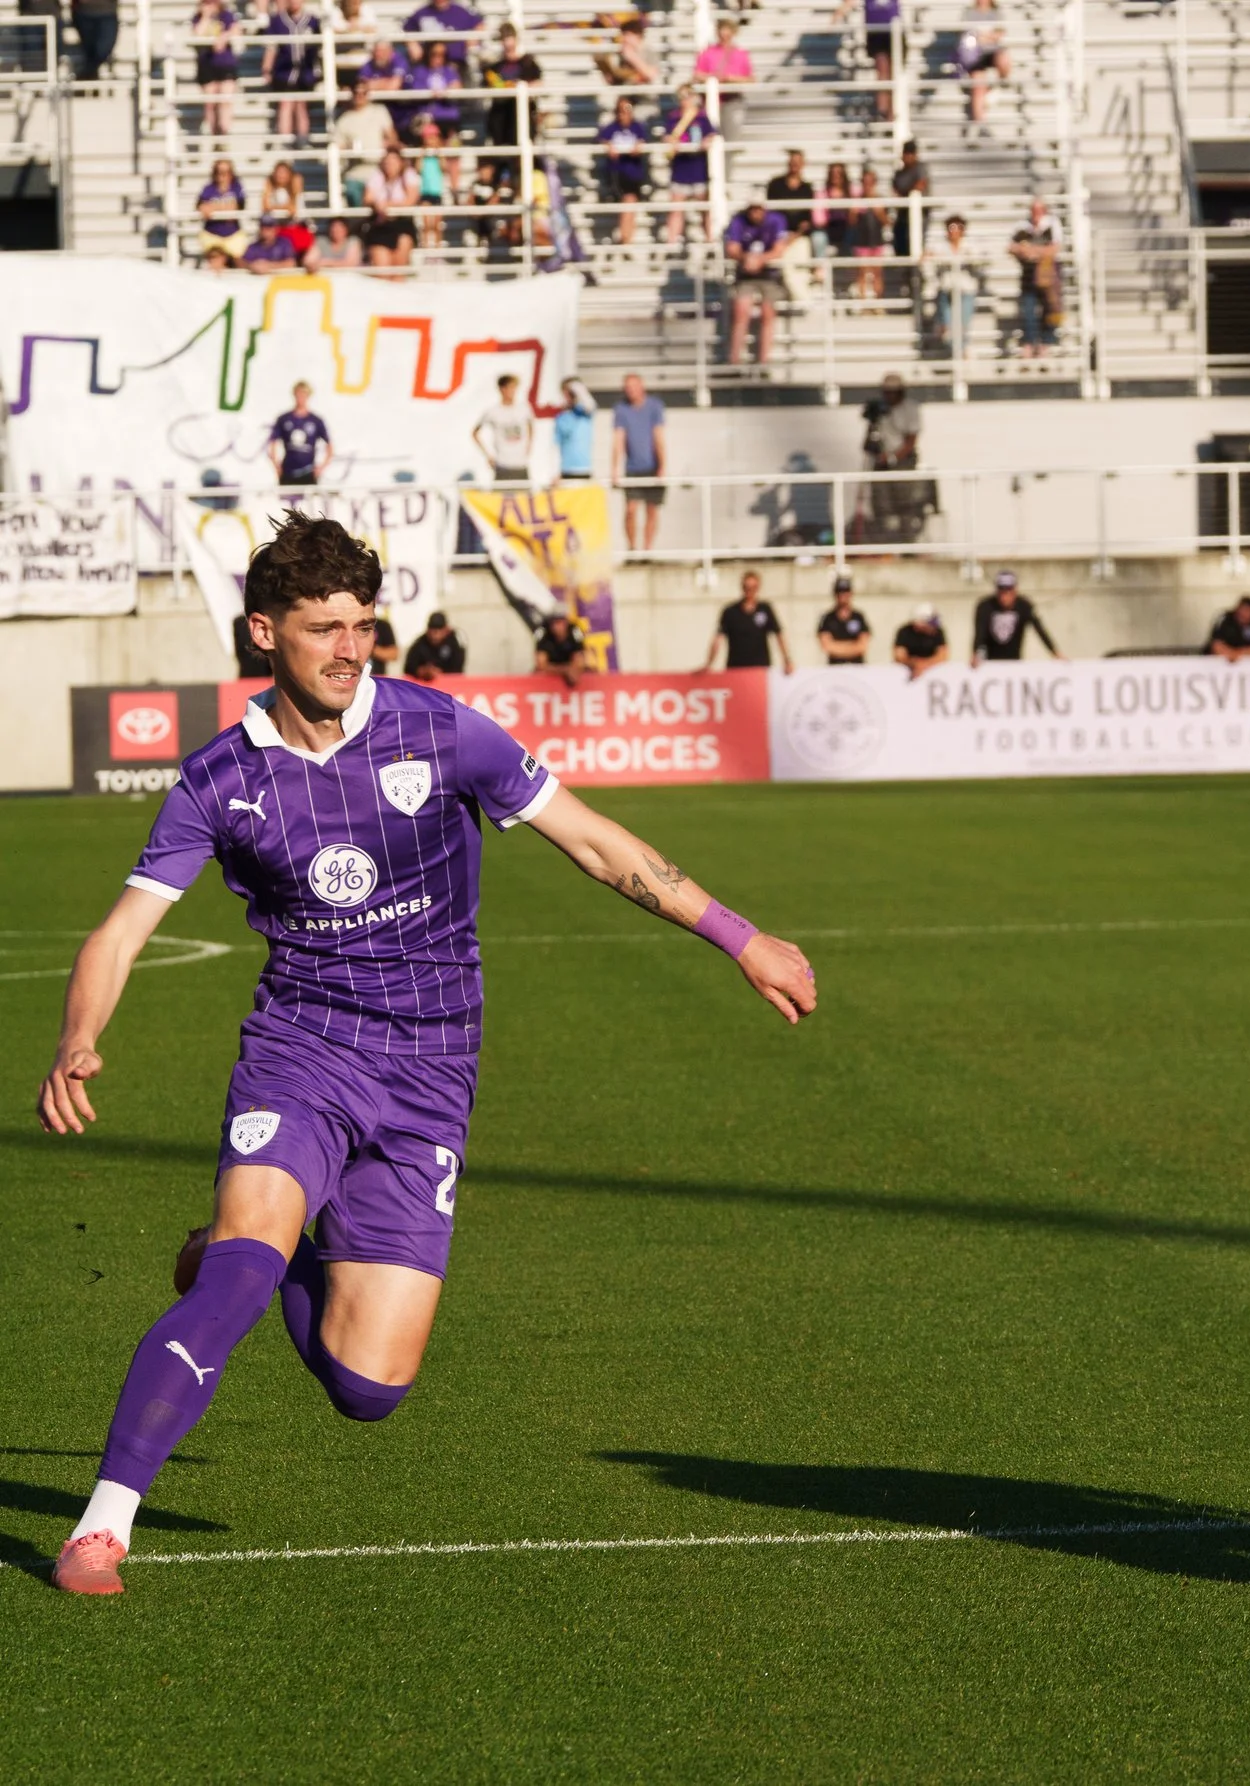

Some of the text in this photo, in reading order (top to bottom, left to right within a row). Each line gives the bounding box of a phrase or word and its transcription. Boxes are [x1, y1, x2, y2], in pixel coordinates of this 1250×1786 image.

[453, 687, 732, 727] AS THE MOST
[927, 677, 1074, 720] RACING
[537, 733, 721, 774] CHOICES
[975, 726, 1159, 751] FOOTBALL
[94, 768, 181, 793] TOYOT
[386, 767, 427, 783] LOUISVILLE
[305, 895, 432, 932] APPLIANCES
[236, 1116, 273, 1129] LOUISVILLE
